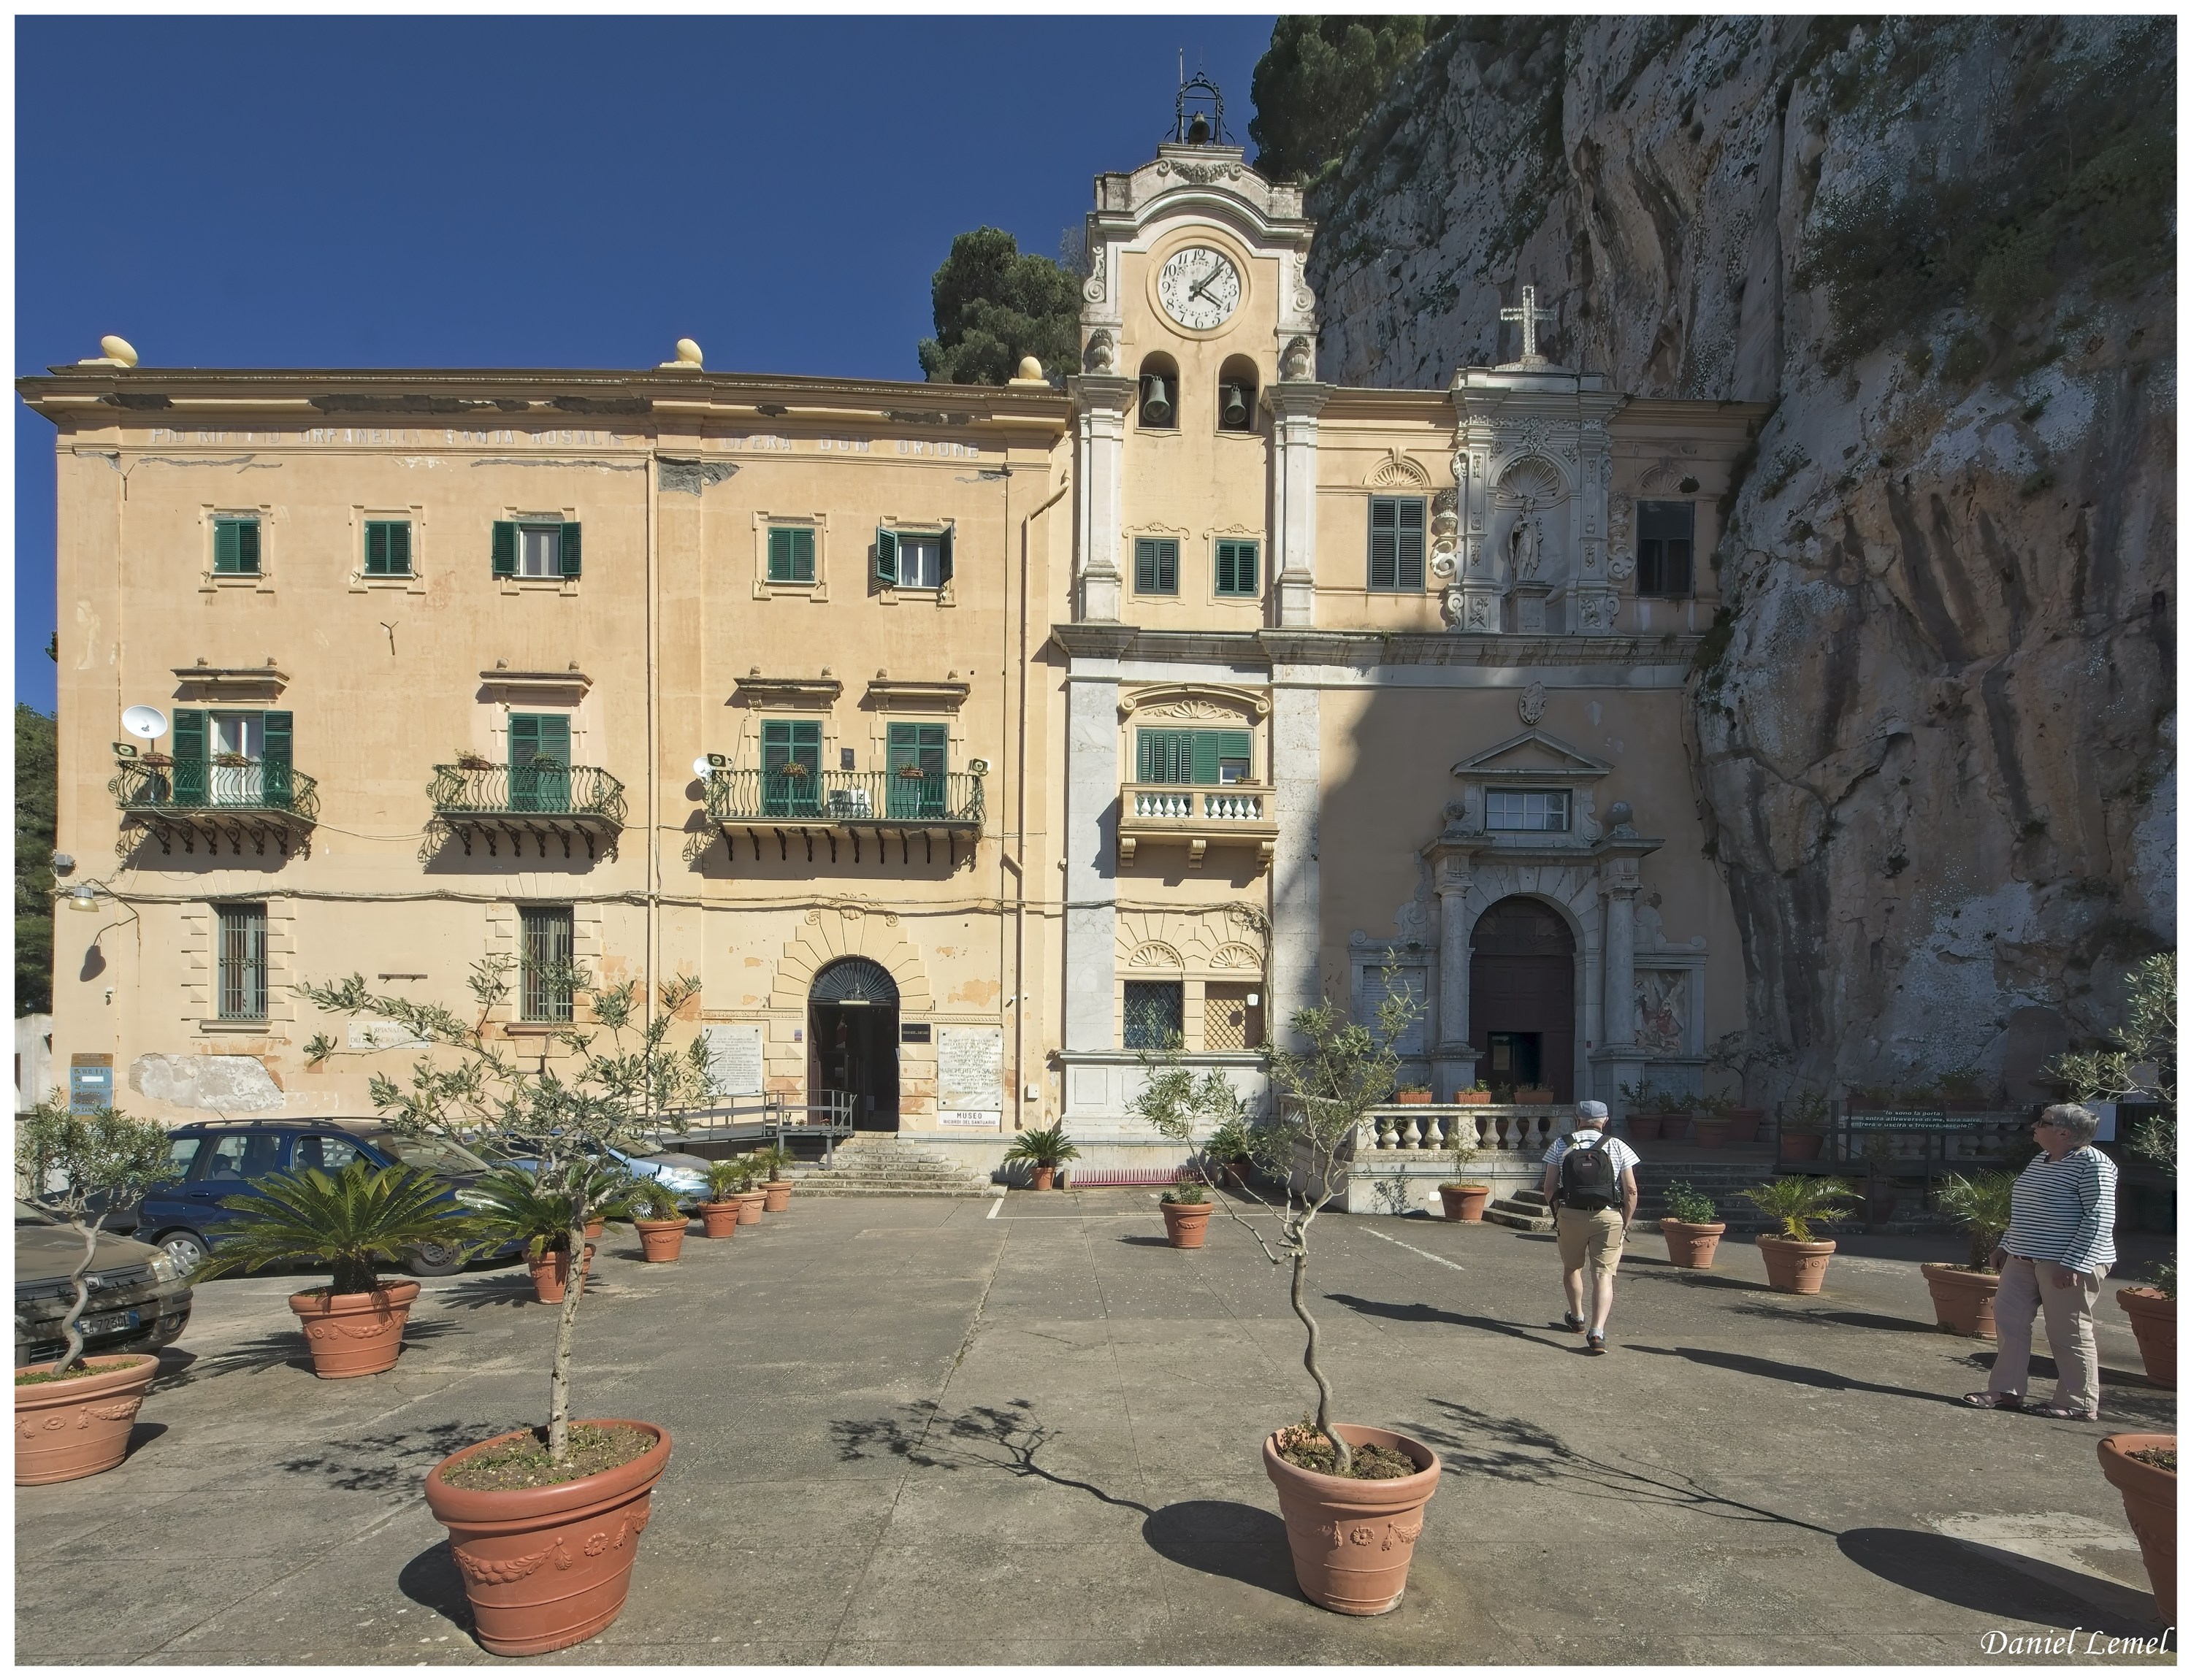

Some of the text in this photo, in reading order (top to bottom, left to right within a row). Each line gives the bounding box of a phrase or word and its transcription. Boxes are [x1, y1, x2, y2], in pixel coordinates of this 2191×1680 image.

[1178, 253, 1188, 264] 11
[1193, 249, 1207, 261] 12
[1163, 264, 1177, 277] 10
[1225, 267, 1234, 279] 2
[1162, 281, 1170, 294] 9
[1228, 285, 1237, 296] 3
[1166, 298, 1174, 310] 8
[1223, 302, 1231, 313] 4
[1179, 310, 1186, 323] 7
[1195, 316, 1204, 329] 6
[1212, 312, 1220, 325] 5
[153, 426, 186, 443] PIO
[723, 434, 979, 458] OPERA DON ORIONE
